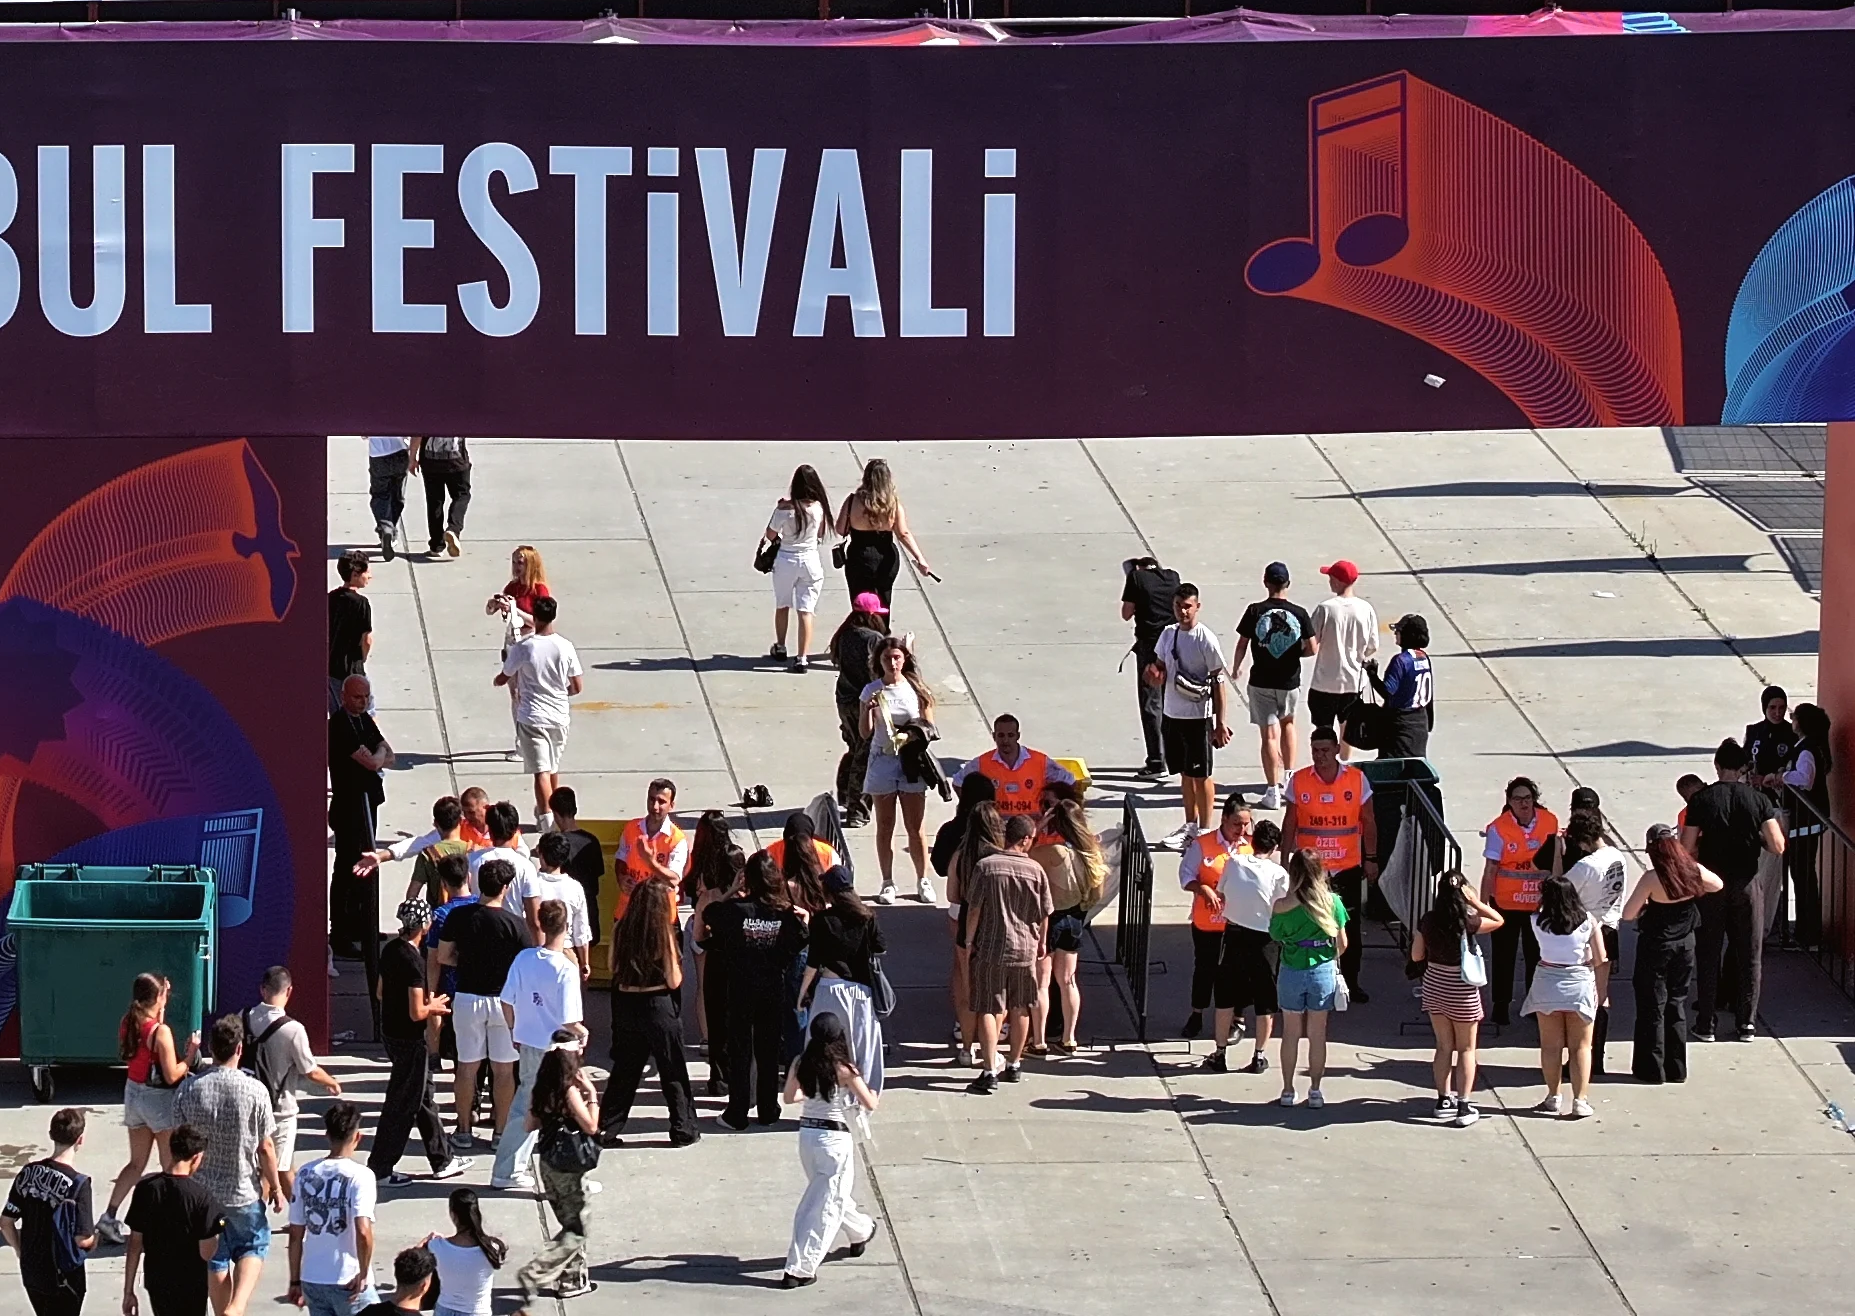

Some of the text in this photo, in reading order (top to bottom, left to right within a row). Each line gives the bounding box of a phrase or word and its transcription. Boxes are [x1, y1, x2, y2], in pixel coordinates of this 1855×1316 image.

[281, 142, 1017, 338] FESTiVALi
[1412, 671, 1432, 708] 10
[1309, 815, 1347, 826] 2491-318
[1316, 835, 1340, 848] ÖZEL
